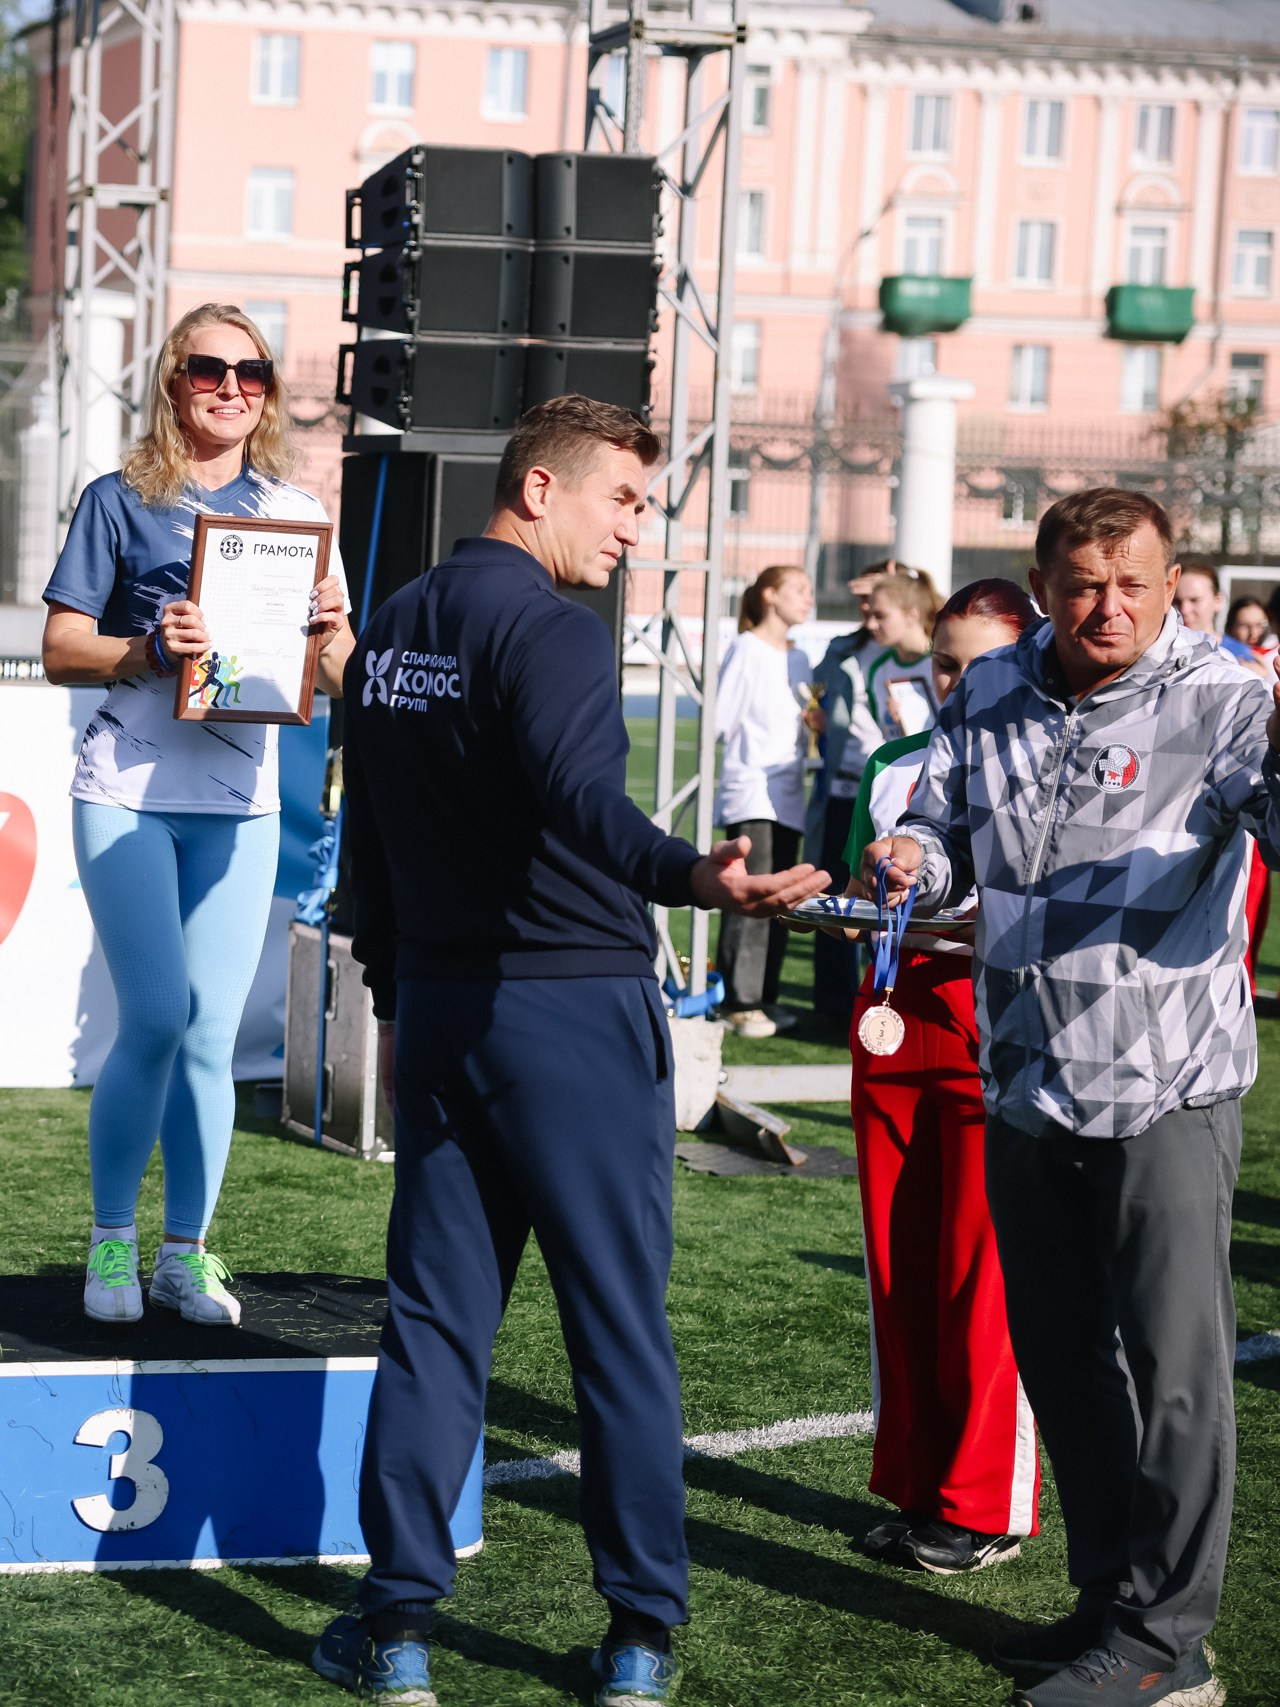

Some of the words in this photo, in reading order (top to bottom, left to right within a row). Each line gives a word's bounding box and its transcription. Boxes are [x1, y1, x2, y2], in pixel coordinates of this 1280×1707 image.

[253, 543, 314, 559] ГРАМОТА
[389, 694, 428, 713] ГРУПП
[71, 1407, 170, 1533] 3
